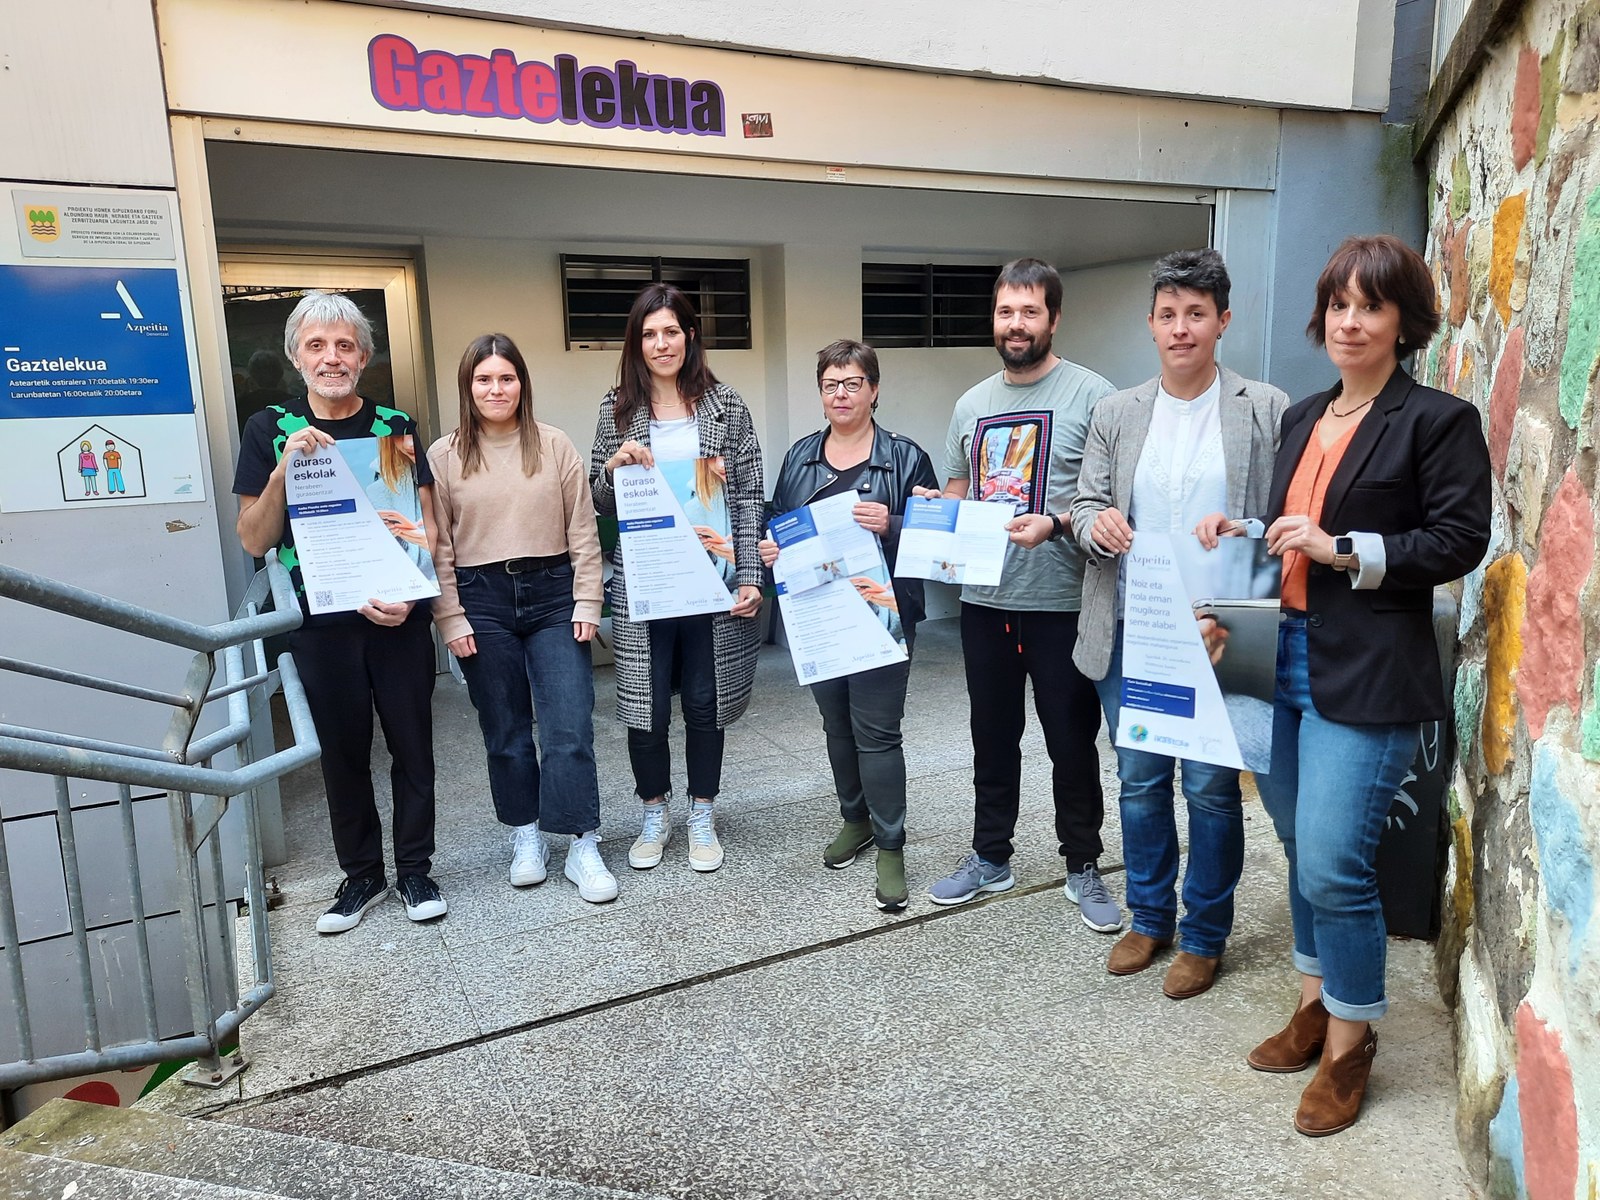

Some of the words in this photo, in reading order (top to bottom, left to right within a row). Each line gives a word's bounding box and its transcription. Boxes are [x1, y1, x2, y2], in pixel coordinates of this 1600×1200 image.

[369, 35, 725, 135] Gaztelekua
[125, 322, 169, 334] Azpeitia
[6, 356, 108, 373] Gaztelekua
[9, 379, 51, 387] Asteartetik
[52, 378, 87, 386] ostiralera
[88, 377, 127, 385] 17:00etatik
[128, 377, 159, 385] 19:30era
[11, 390, 62, 399] Larunbatetan
[63, 389, 102, 397] 16:00etatik
[104, 389, 142, 397] 20:00etara
[293, 456, 332, 469] Guraso
[294, 468, 337, 481] eskolak
[621, 477, 656, 487] Guraso
[623, 487, 660, 499] eskolak
[1129, 553, 1171, 567] Azpeitia
[1131, 578, 1148, 589] Noiz
[1149, 580, 1163, 590] eta
[1130, 592, 1147, 601] nola
[1148, 594, 1173, 604] eman
[1129, 605, 1171, 617] mugikorra
[1129, 619, 1150, 629] seme
[1151, 620, 1177, 631] alabei
